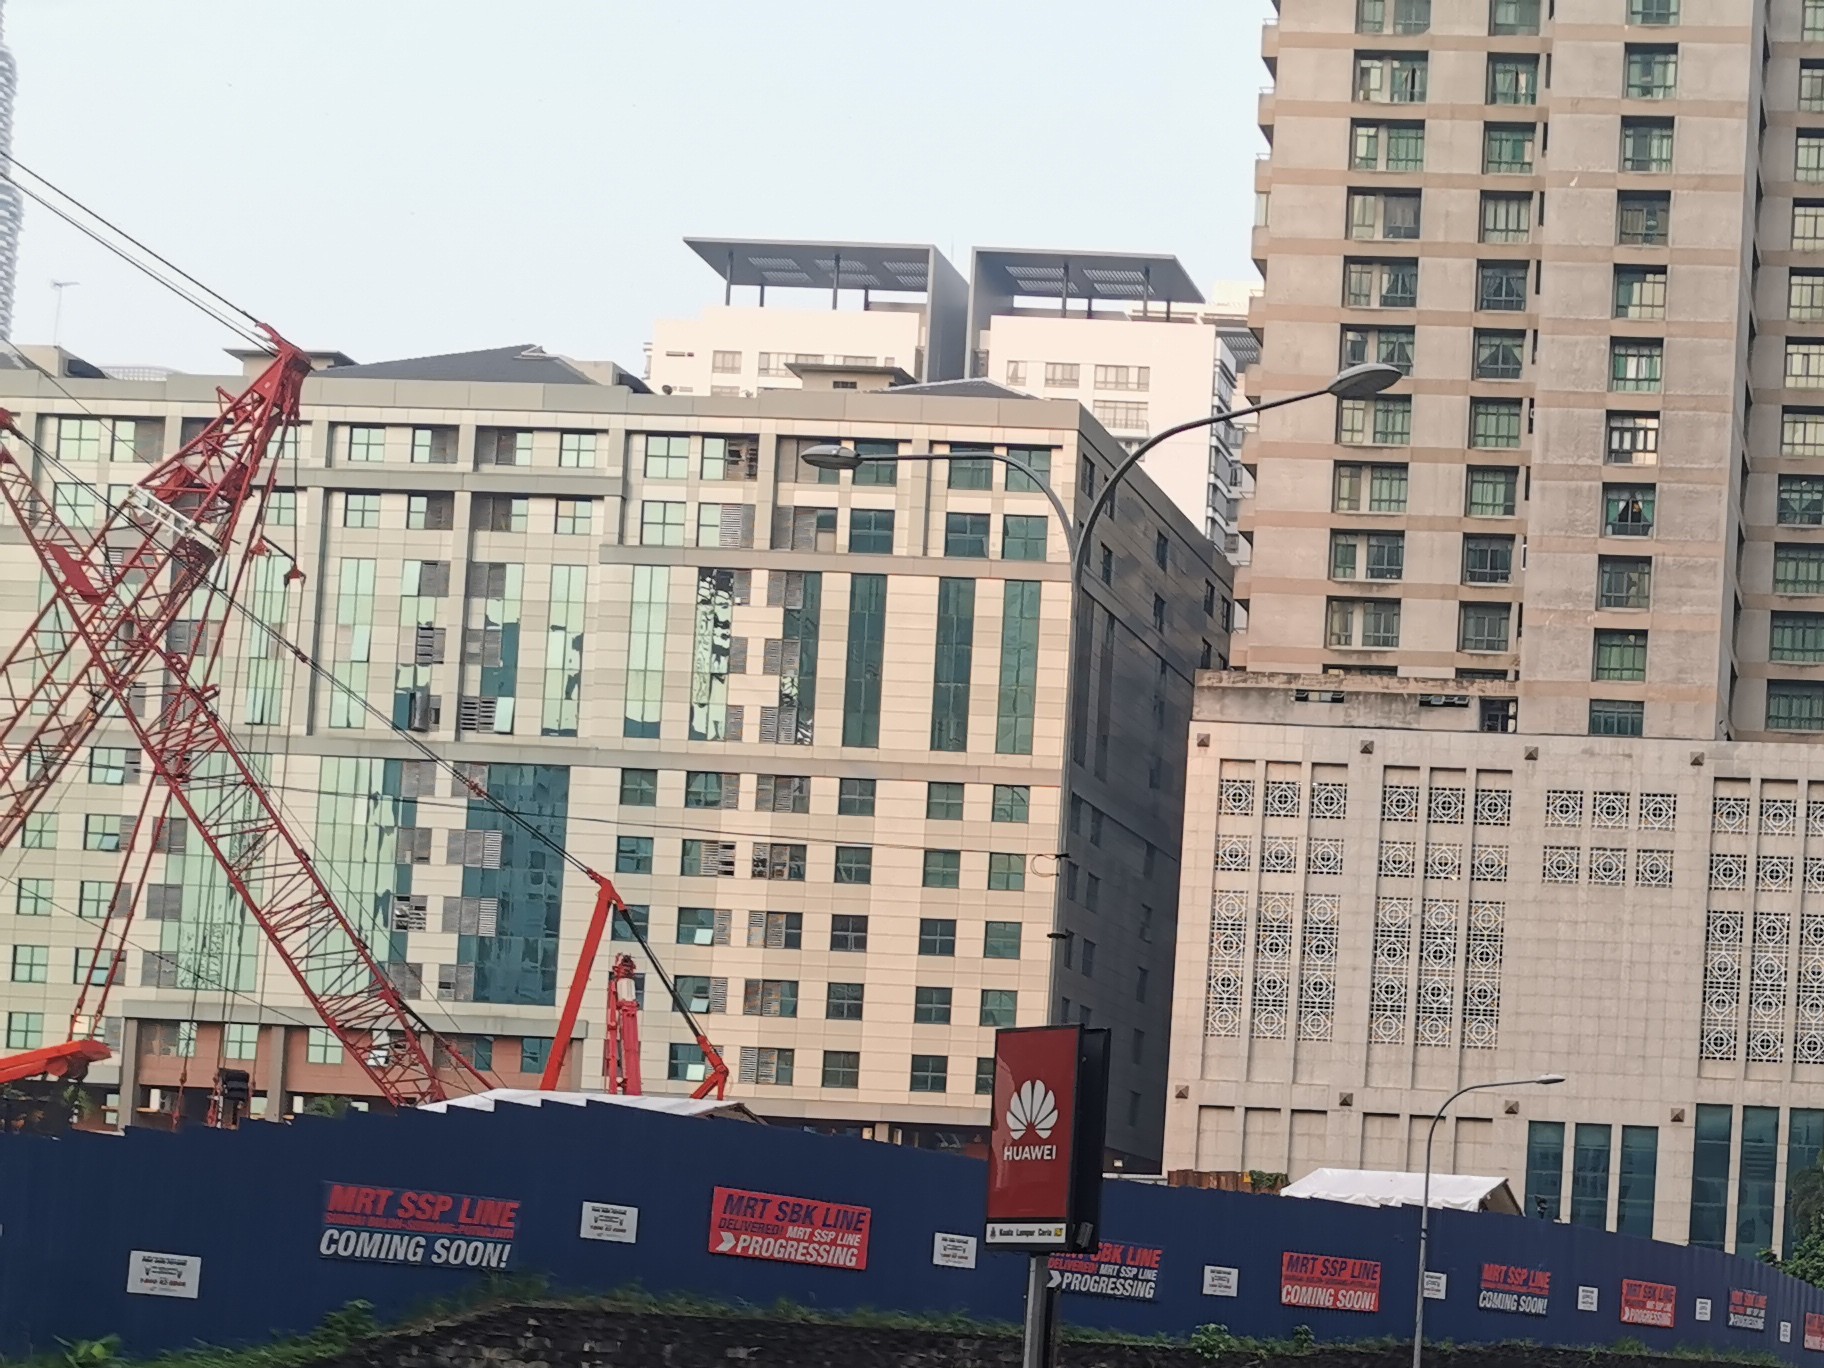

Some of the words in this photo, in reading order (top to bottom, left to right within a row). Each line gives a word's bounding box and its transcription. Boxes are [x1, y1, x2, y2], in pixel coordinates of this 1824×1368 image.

[1003, 1145, 1057, 1161] HUAWEI
[328, 1184, 394, 1216] MRT
[397, 1191, 454, 1221] SSP
[458, 1197, 521, 1228] LINE
[722, 1193, 772, 1220] MRT
[775, 1200, 819, 1227] SBK
[821, 1207, 867, 1232] LINE
[320, 1228, 426, 1263] COMING
[431, 1238, 512, 1269] SOON!
[786, 1225, 813, 1241] MRT
[813, 1228, 836, 1244] SSP
[837, 1232, 862, 1247] LINE
[736, 1235, 859, 1267] PROGRESSING
[1126, 1246, 1163, 1269] LINE
[1099, 1263, 1120, 1276] MRT
[1120, 1265, 1138, 1278] SSP
[1287, 1255, 1319, 1275] MRT
[1320, 1258, 1348, 1277] SSP
[1350, 1261, 1379, 1281] LINE
[1483, 1263, 1508, 1283] MRT
[1507, 1266, 1529, 1285] SSP
[1062, 1271, 1156, 1299] PROGRESSING
[1282, 1284, 1335, 1307] COMING
[1336, 1289, 1376, 1310] SOON!
[1479, 1291, 1519, 1311] COMING
[1519, 1295, 1549, 1315] SOON!
